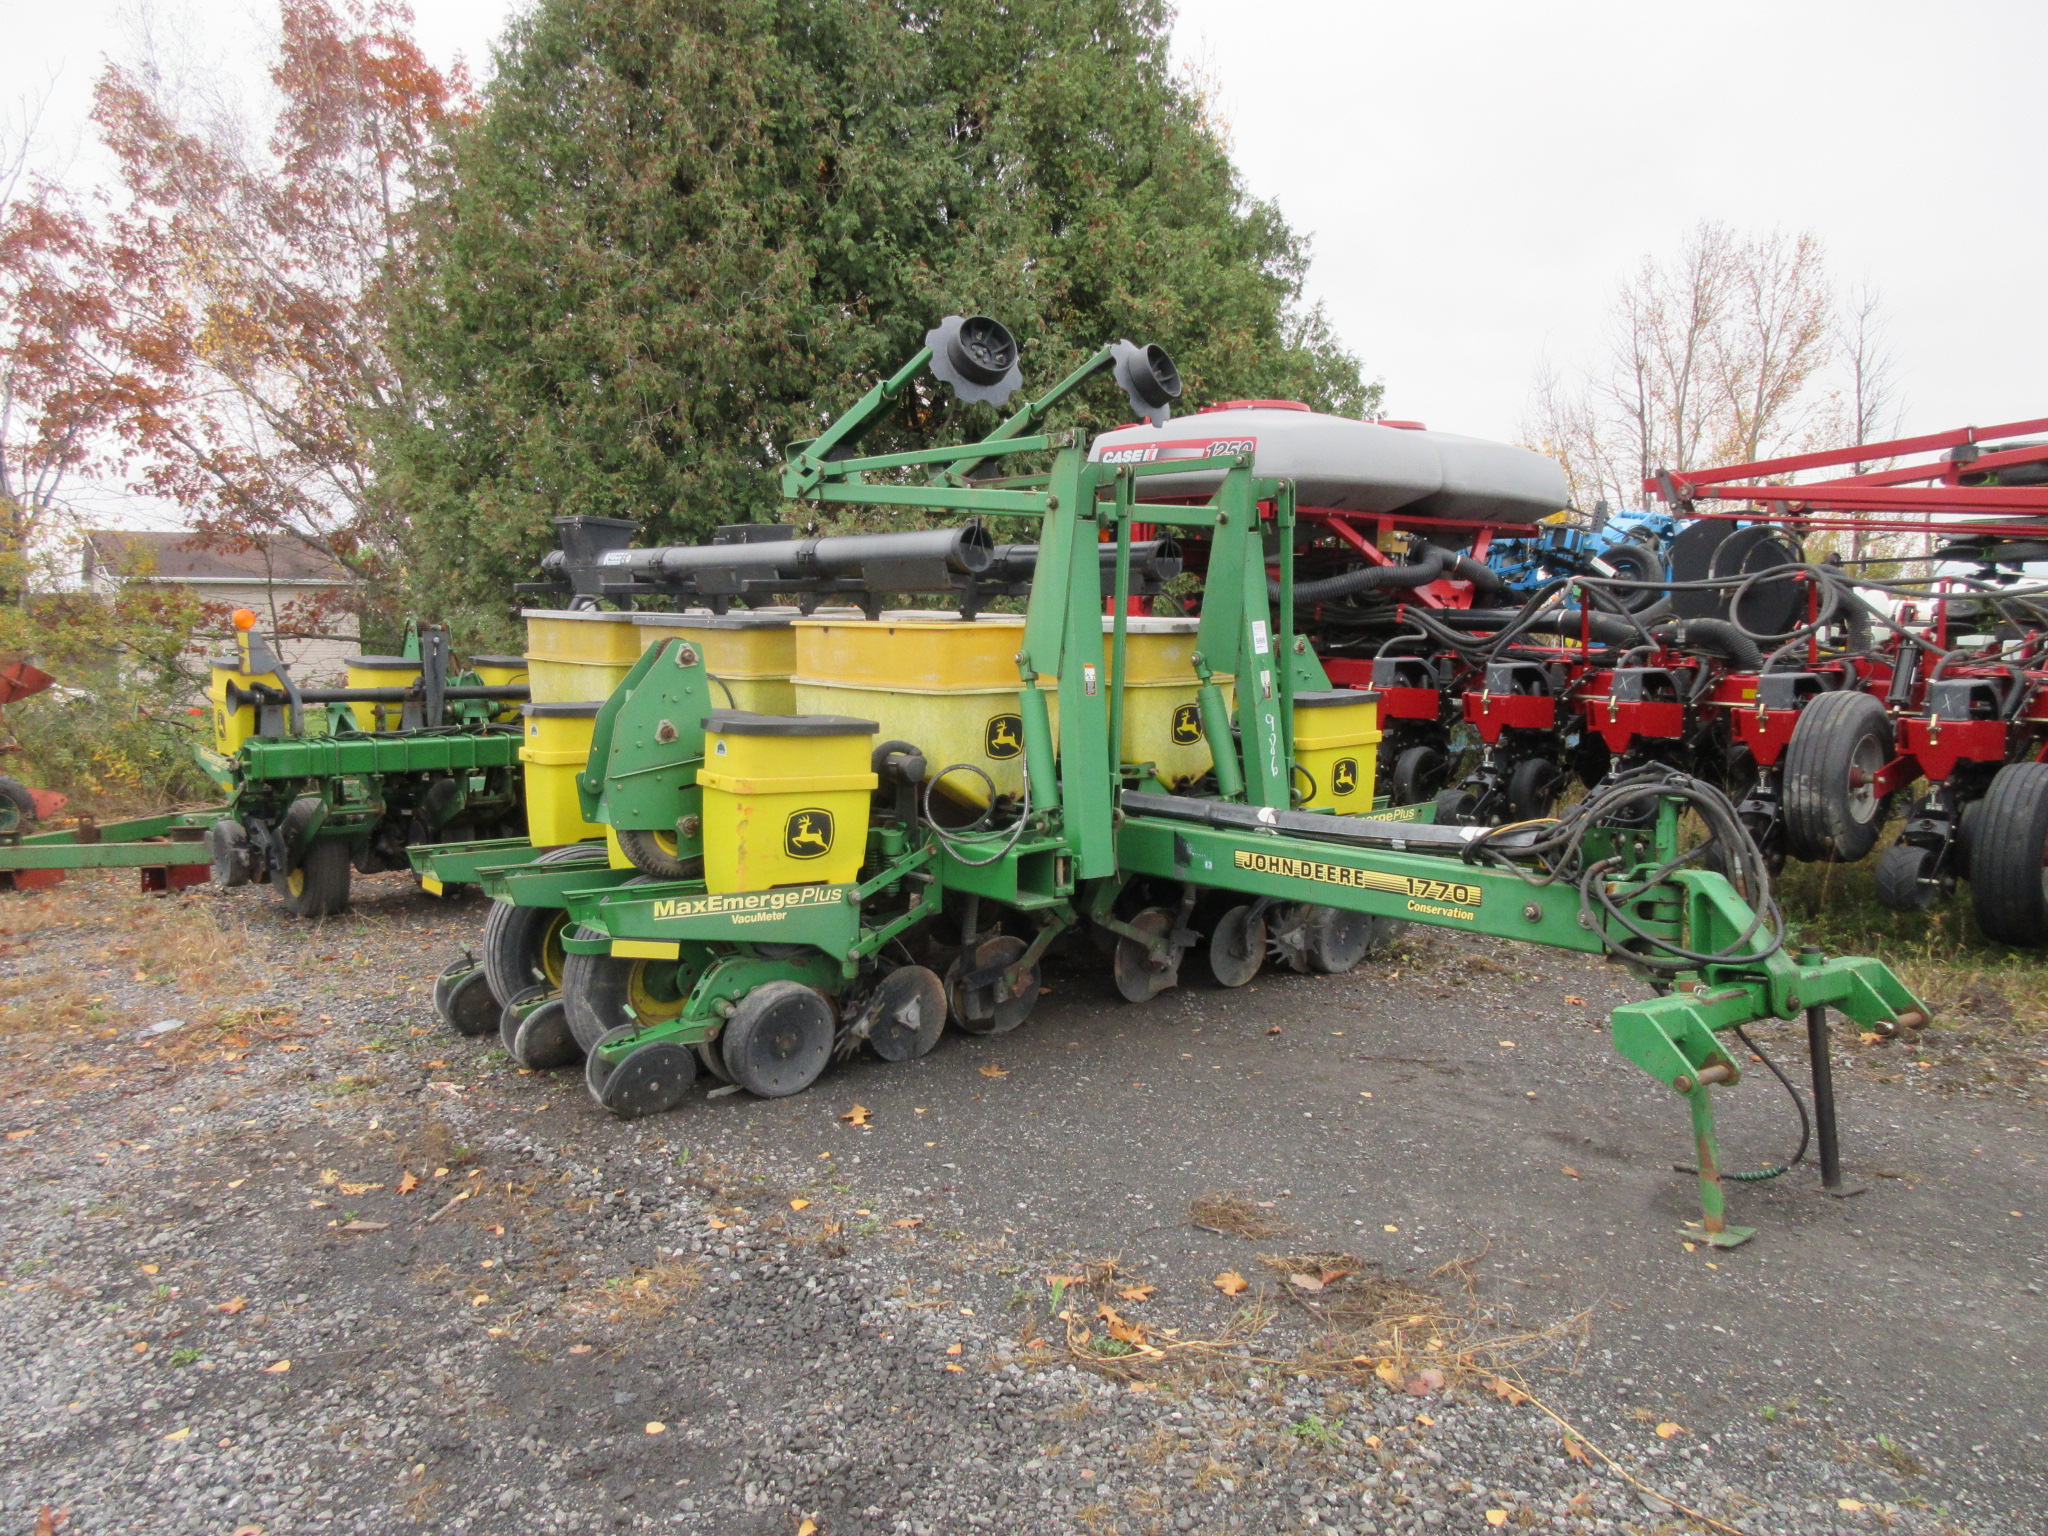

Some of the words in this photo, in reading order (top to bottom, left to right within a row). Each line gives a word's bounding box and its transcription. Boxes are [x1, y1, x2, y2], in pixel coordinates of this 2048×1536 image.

[1102, 449, 1143, 463] CASE
[1265, 713, 1279, 777] 986
[1242, 853, 1294, 876] JOHN
[1300, 861, 1365, 888] DEERE
[1406, 877, 1470, 904] 1770
[653, 886, 843, 918] MaxEmergePlus
[1406, 899, 1475, 921] Conservation
[731, 910, 788, 925] VacuMeter
